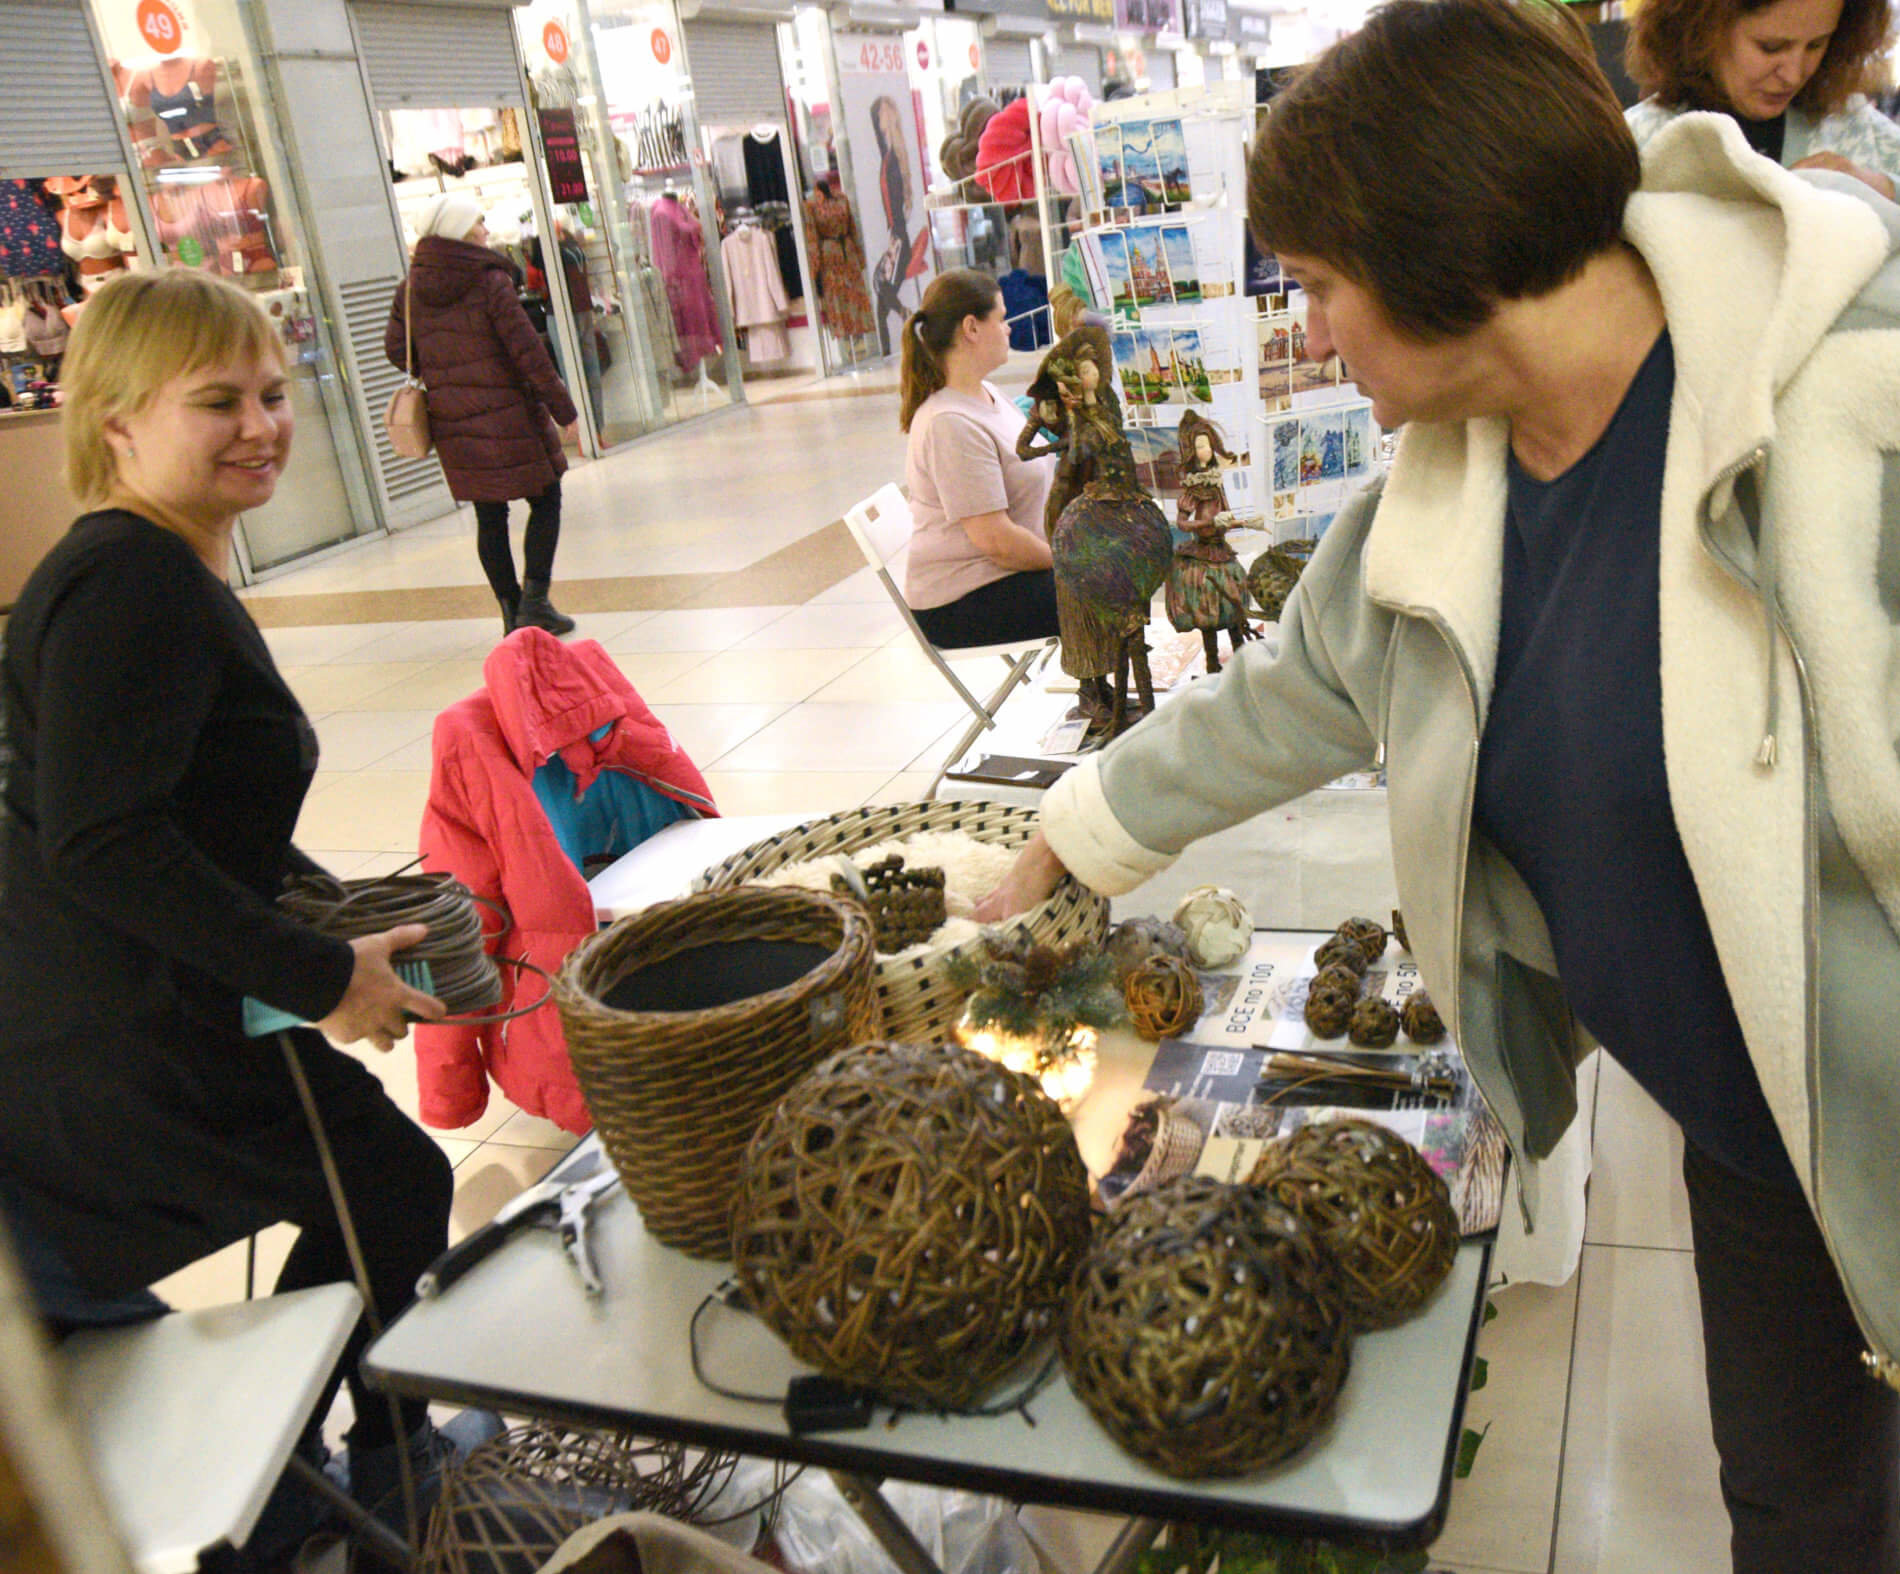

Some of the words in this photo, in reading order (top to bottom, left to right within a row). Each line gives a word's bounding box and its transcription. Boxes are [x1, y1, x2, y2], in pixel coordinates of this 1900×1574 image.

[145, 12, 174, 40] 49
[547, 31, 564, 55] 48
[860, 43, 903, 71] 42-56
[1249, 963, 1275, 984] 100
[1397, 963, 1417, 977] 50
[1244, 988, 1263, 1003] по
[1396, 981, 1414, 995] по
[1225, 1007, 1255, 1033] ВСЕ
